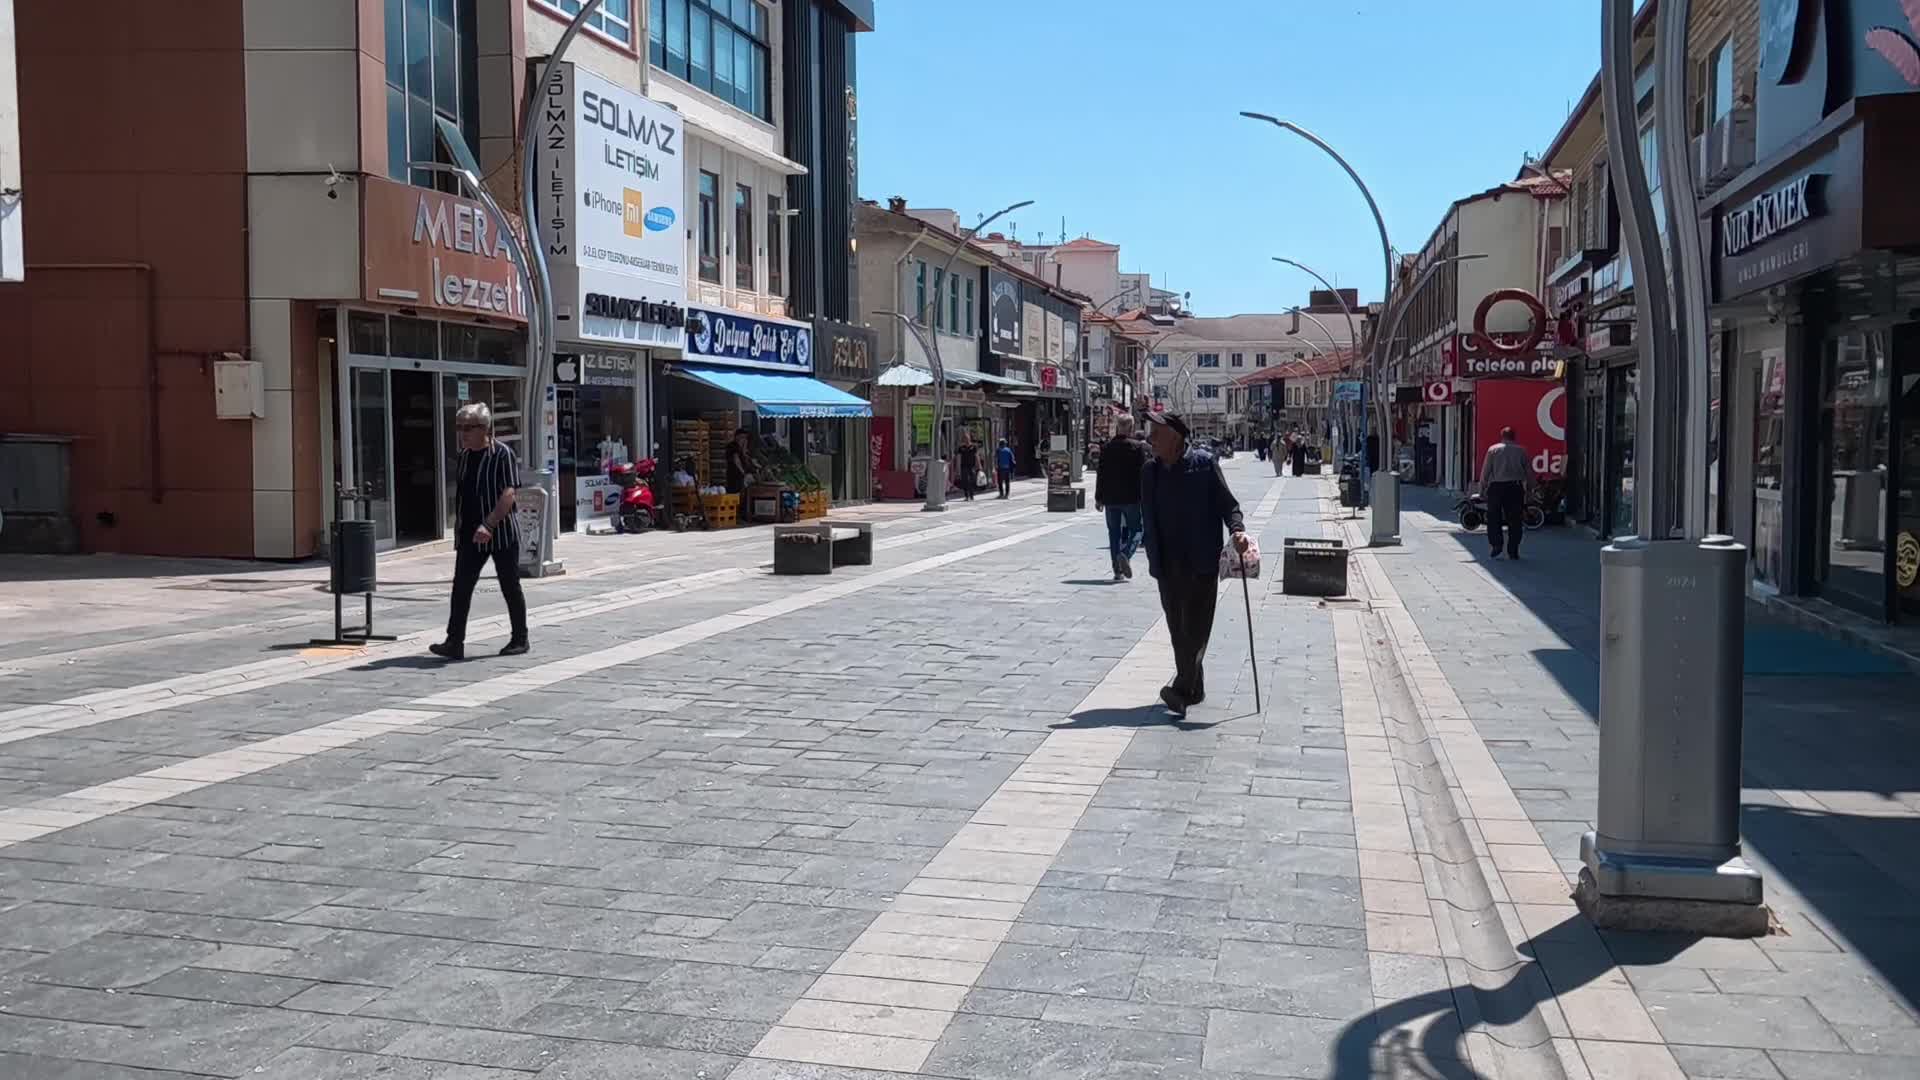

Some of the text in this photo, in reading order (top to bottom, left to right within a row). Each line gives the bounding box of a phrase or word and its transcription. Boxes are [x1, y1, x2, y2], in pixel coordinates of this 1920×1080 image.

[547, 69, 566, 150] SOLMAZ
[583, 90, 676, 156] SOLMAZ
[604, 138, 660, 182] İLETİŞİM
[592, 191, 623, 216] iPhone
[1722, 173, 1810, 258] NUR EKMEK
[412, 191, 517, 262] MERA
[585, 293, 641, 322] SOLMAZ
[714, 318, 750, 354] Dalyan
[751, 323, 777, 358] Balık
[1466, 357, 1526, 373] Telefon
